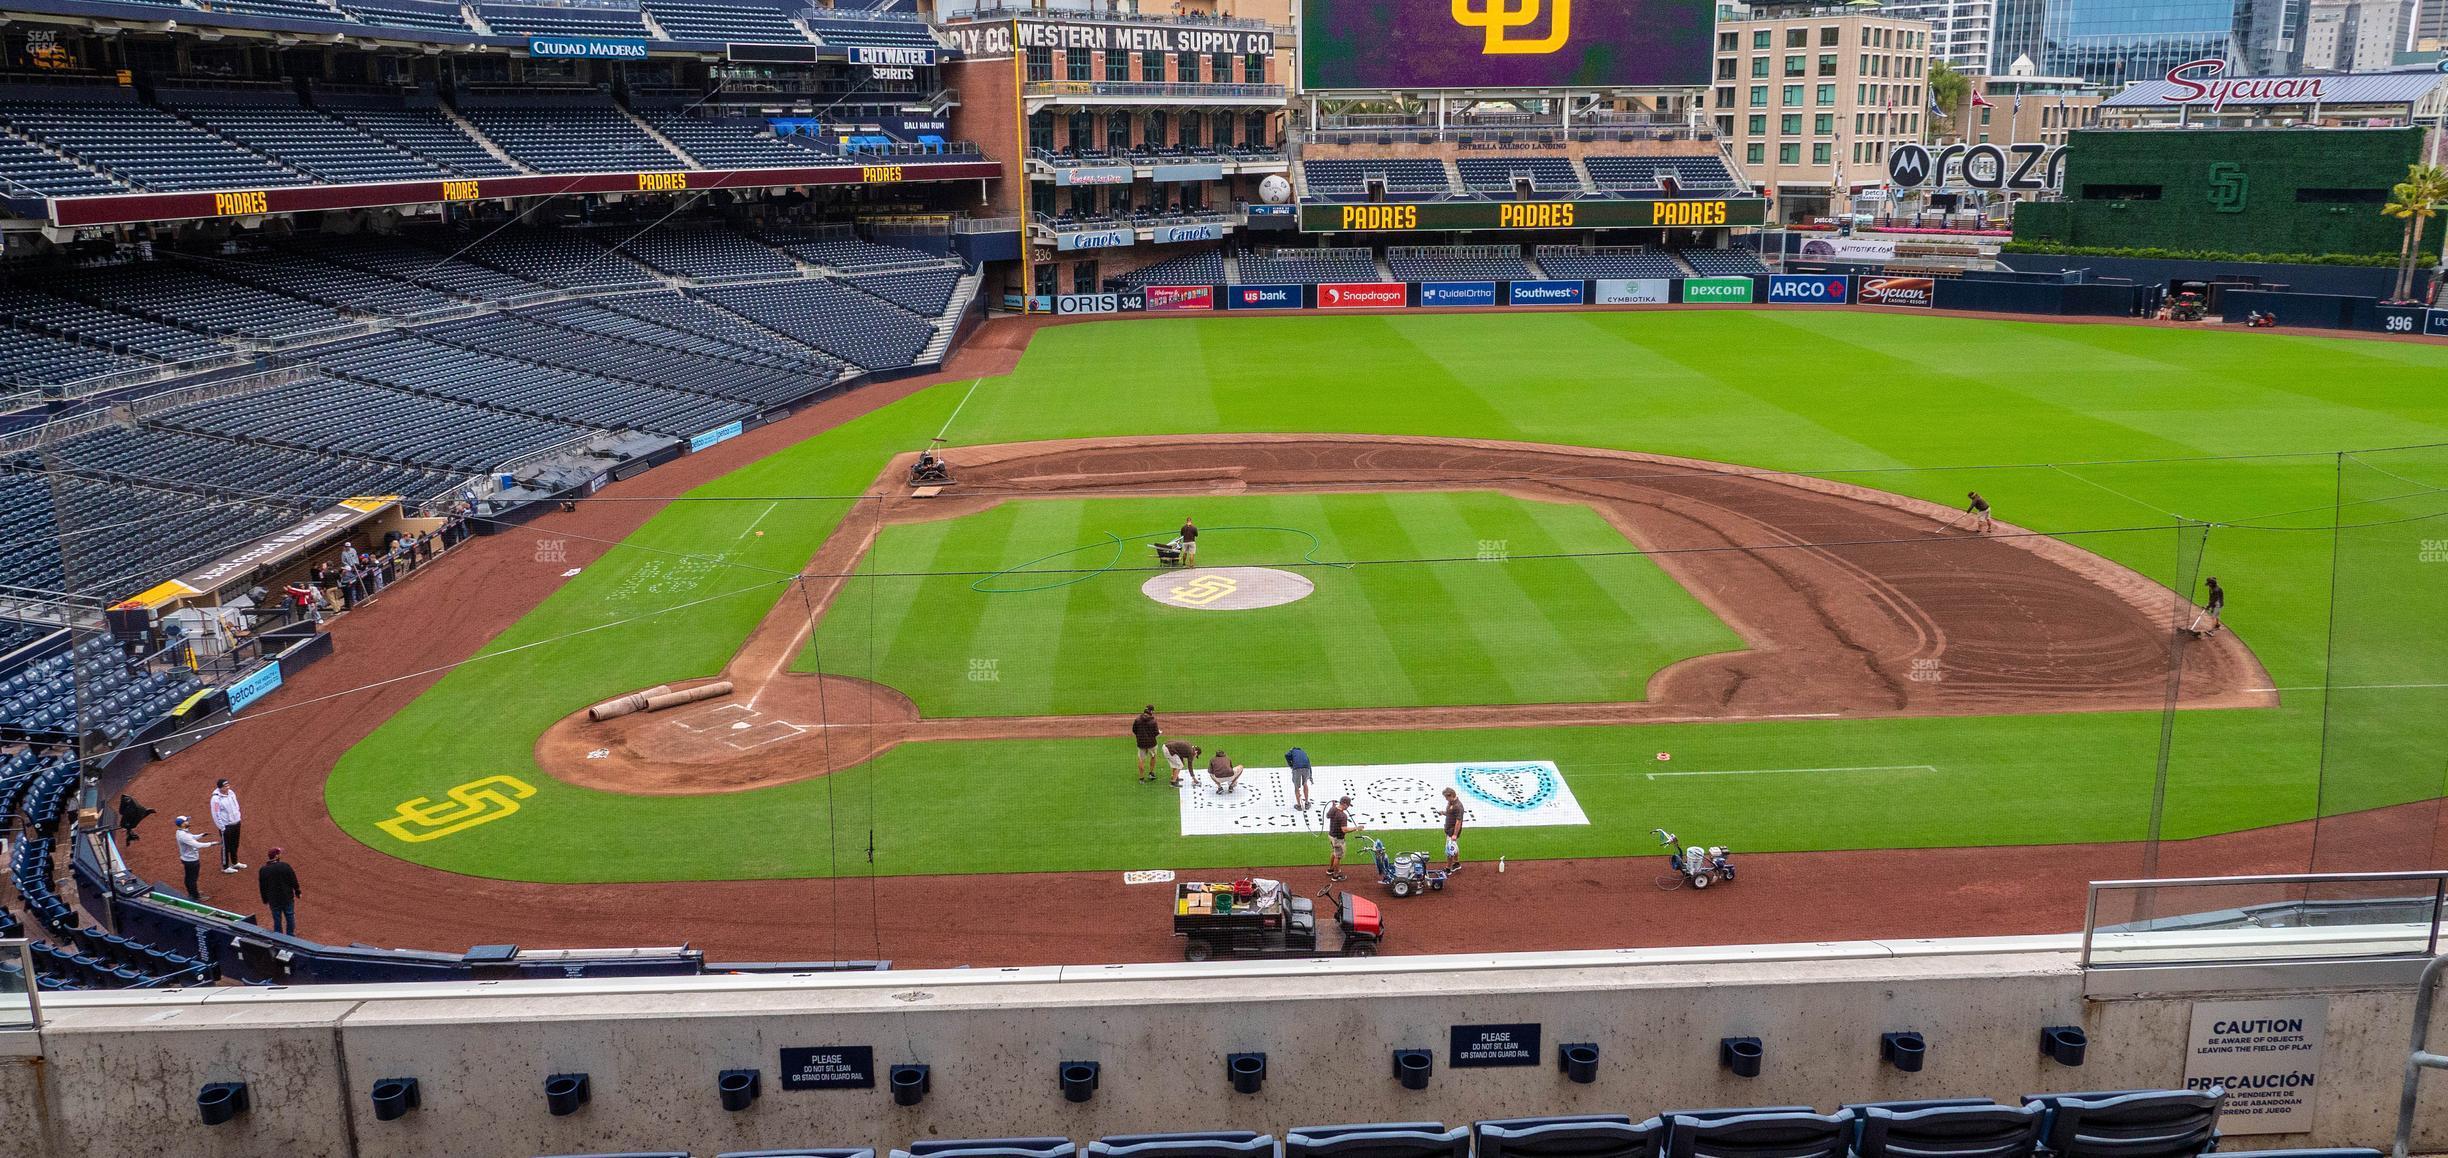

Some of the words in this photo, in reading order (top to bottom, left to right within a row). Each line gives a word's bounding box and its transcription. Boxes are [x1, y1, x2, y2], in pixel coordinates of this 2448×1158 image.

[986, 27, 1014, 53] CO.
[1017, 24, 1107, 49] WESTERN
[1115, 27, 1173, 51] METAL
[1177, 30, 1240, 53] SUPPLY
[1247, 34, 1273, 54] CO.
[533, 41, 587, 55] CIUDAD
[589, 42, 646, 57] MADERAS
[859, 48, 927, 65] CUTWATER
[872, 68, 914, 80] SPIRITS
[2161, 59, 2327, 113] Sycuan
[904, 121, 919, 130] BALI
[919, 122, 930, 130] HAI
[931, 122, 945, 130] RUM
[639, 172, 687, 190] PADRES
[863, 166, 902, 182] PADRES
[443, 181, 480, 200] PADRES
[215, 191, 268, 215] PADRES
[1343, 205, 1416, 229] PADRES
[1500, 203, 1574, 227] PADRES
[1653, 201, 1726, 225] PADRES
[1072, 231, 1121, 249] Canel's
[1168, 226, 1211, 242] Canel's
[1034, 249, 1052, 261] 336
[1841, 245, 1893, 254] NITTOTIRE.COM
[1244, 291, 1258, 301] us
[1259, 290, 1287, 301] bank
[1343, 290, 1401, 302] Snapdragon
[1438, 289, 1492, 299] QuidelOrtho
[1514, 287, 1571, 298] Southwest
[1771, 282, 1825, 297] ARCO
[1862, 279, 1925, 303] Sycuan
[1060, 296, 1115, 312] ORIS
[1122, 296, 1142, 310] 342
[2385, 315, 2413, 331] 396
[1235, 807, 1476, 828] caliorni
[2213, 1019, 2303, 1034] CAUTION
[1481, 1032, 1511, 1042] PLEASE
[2267, 1035, 2304, 1043] OBJECTS
[1469, 1051, 1488, 1059] STAND
[2198, 1046, 2233, 1054] LEAVING
[811, 1055, 842, 1064] PLEASE
[801, 1073, 820, 1081] STAND
[2187, 1070, 2315, 1089] PRECAUCIÓN
[2220, 1108, 2251, 1116] ERRENO
